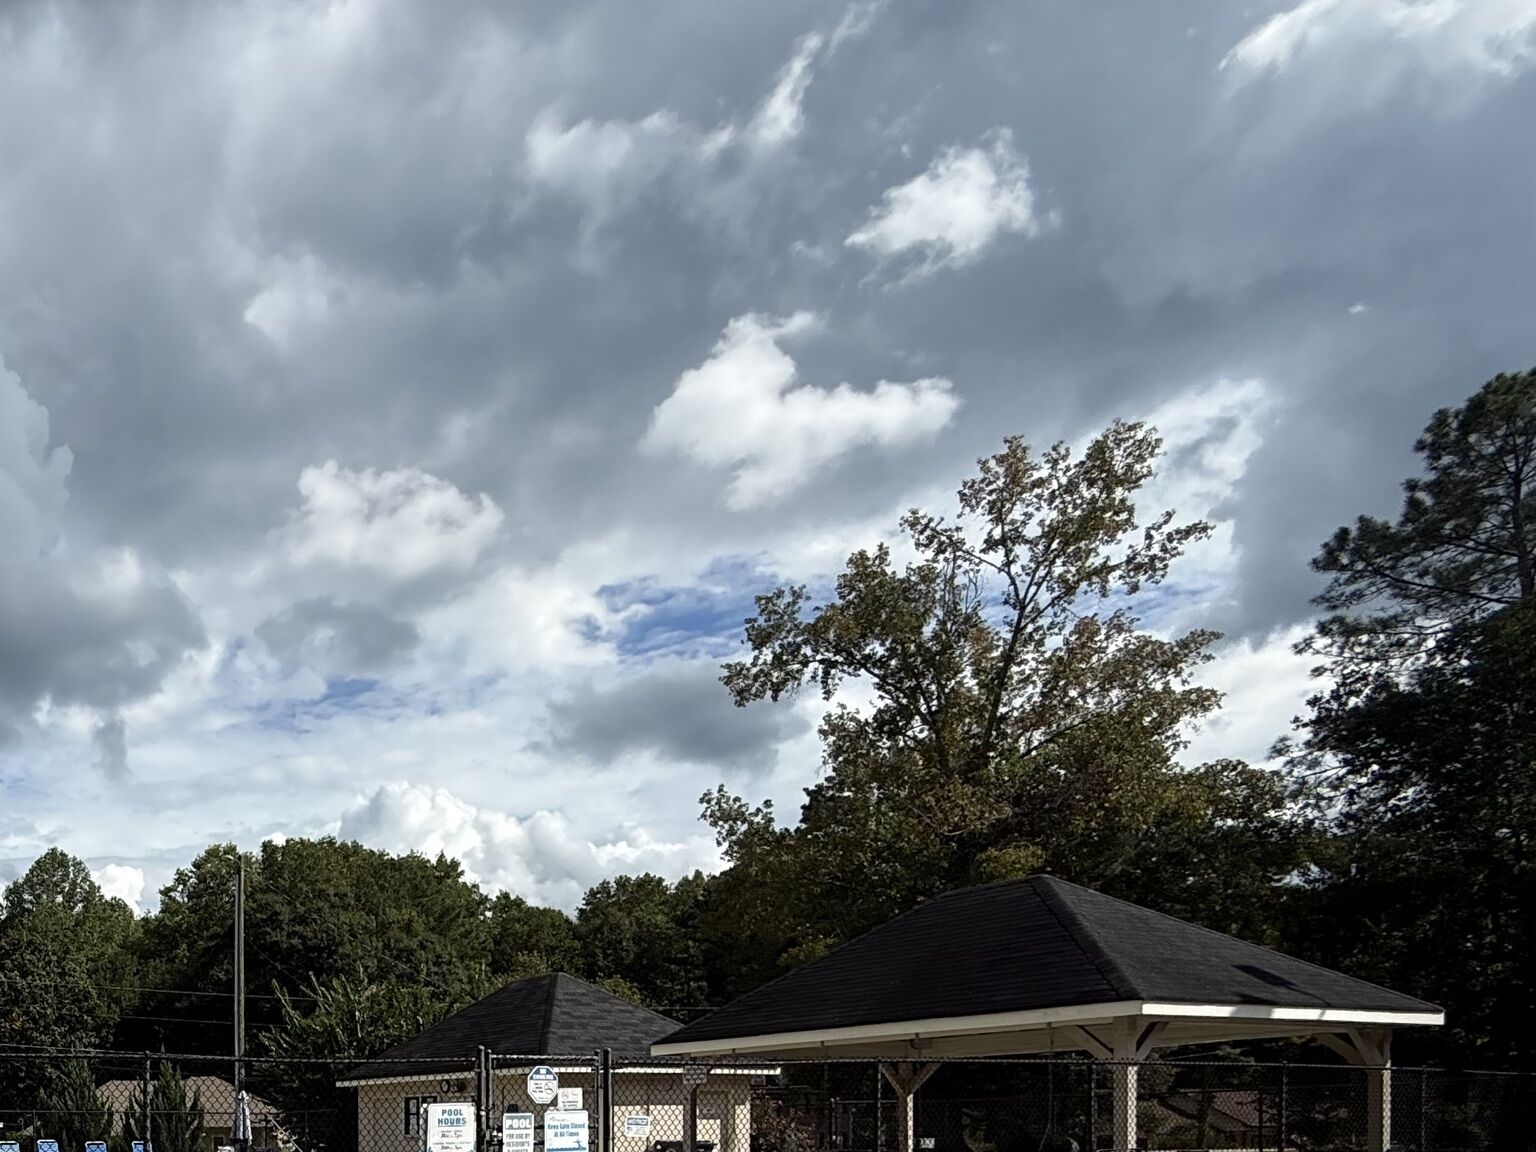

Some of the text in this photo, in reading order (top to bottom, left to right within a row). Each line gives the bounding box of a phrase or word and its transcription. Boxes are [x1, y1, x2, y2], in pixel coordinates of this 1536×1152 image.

[441, 1109, 463, 1117] POOL
[437, 1117, 467, 1125] HOURS
[505, 1118, 531, 1129] POOL
